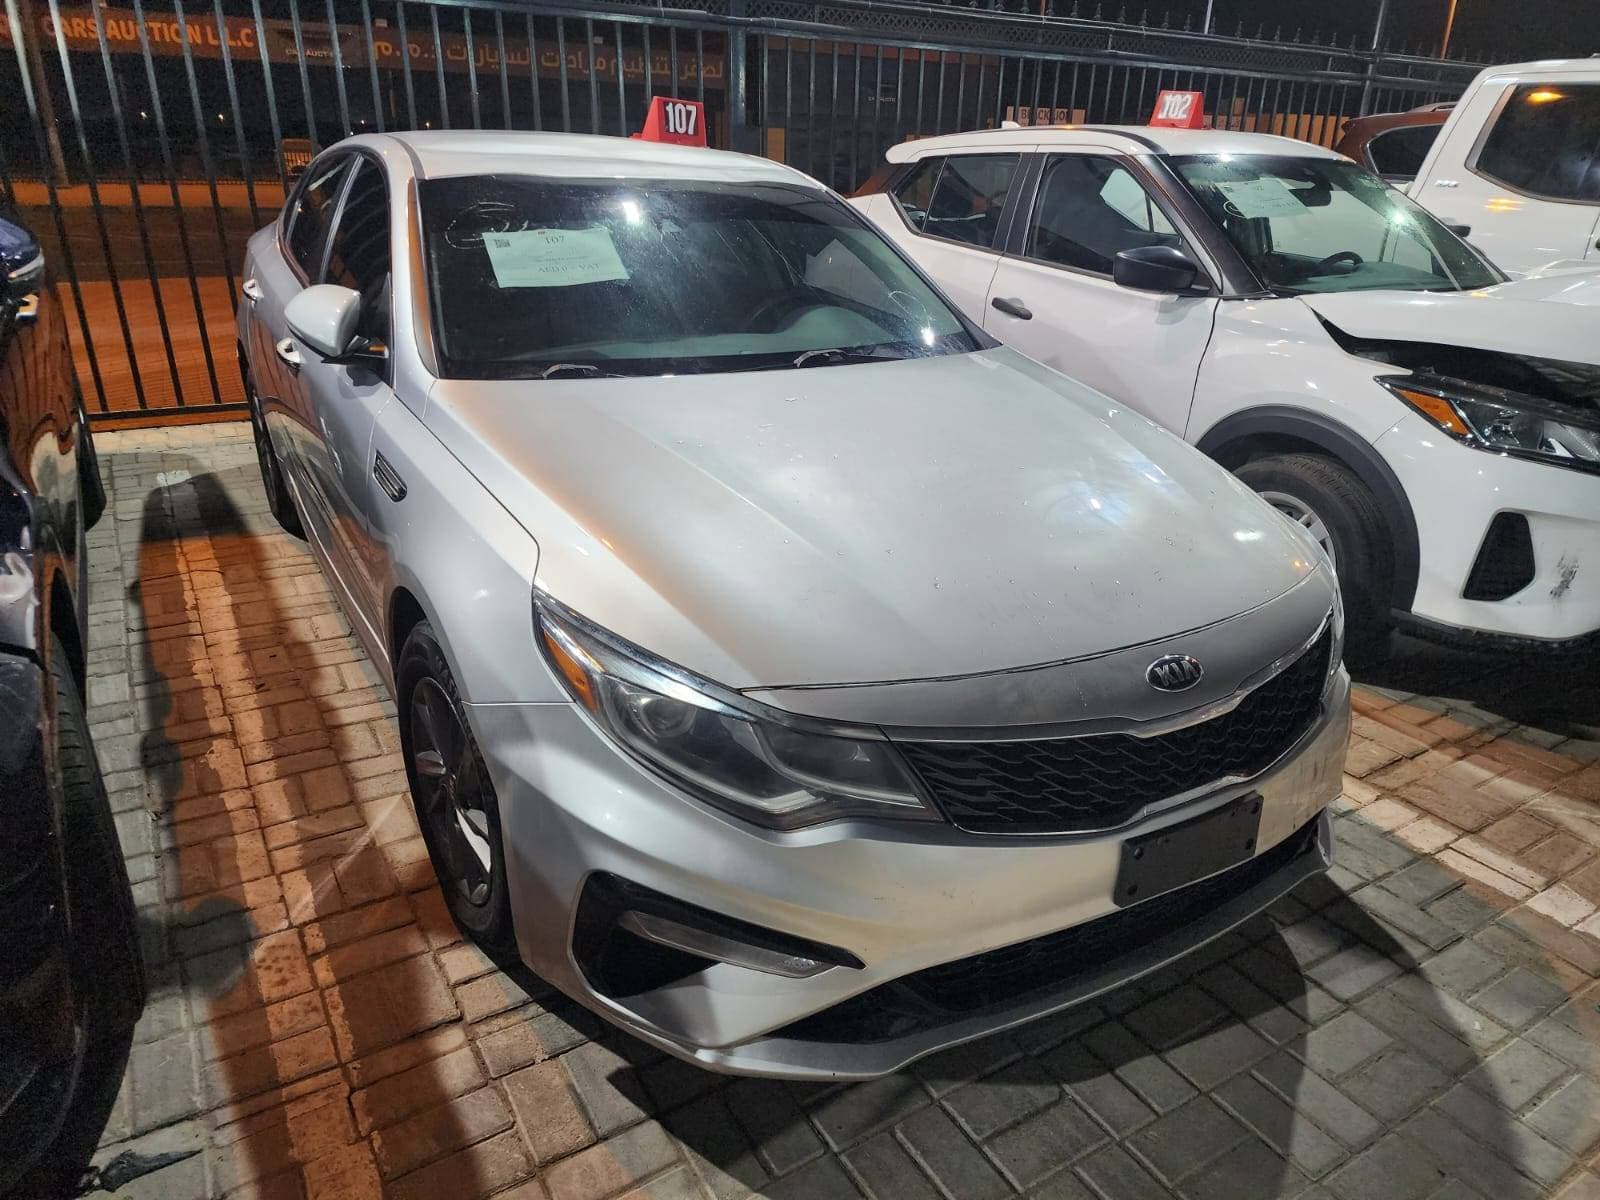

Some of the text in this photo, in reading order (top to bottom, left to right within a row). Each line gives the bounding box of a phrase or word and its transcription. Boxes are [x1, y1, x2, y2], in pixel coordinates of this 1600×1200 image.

[665, 102, 697, 135] 107
[1157, 94, 1193, 119] 102
[1154, 661, 1200, 687] KIA
